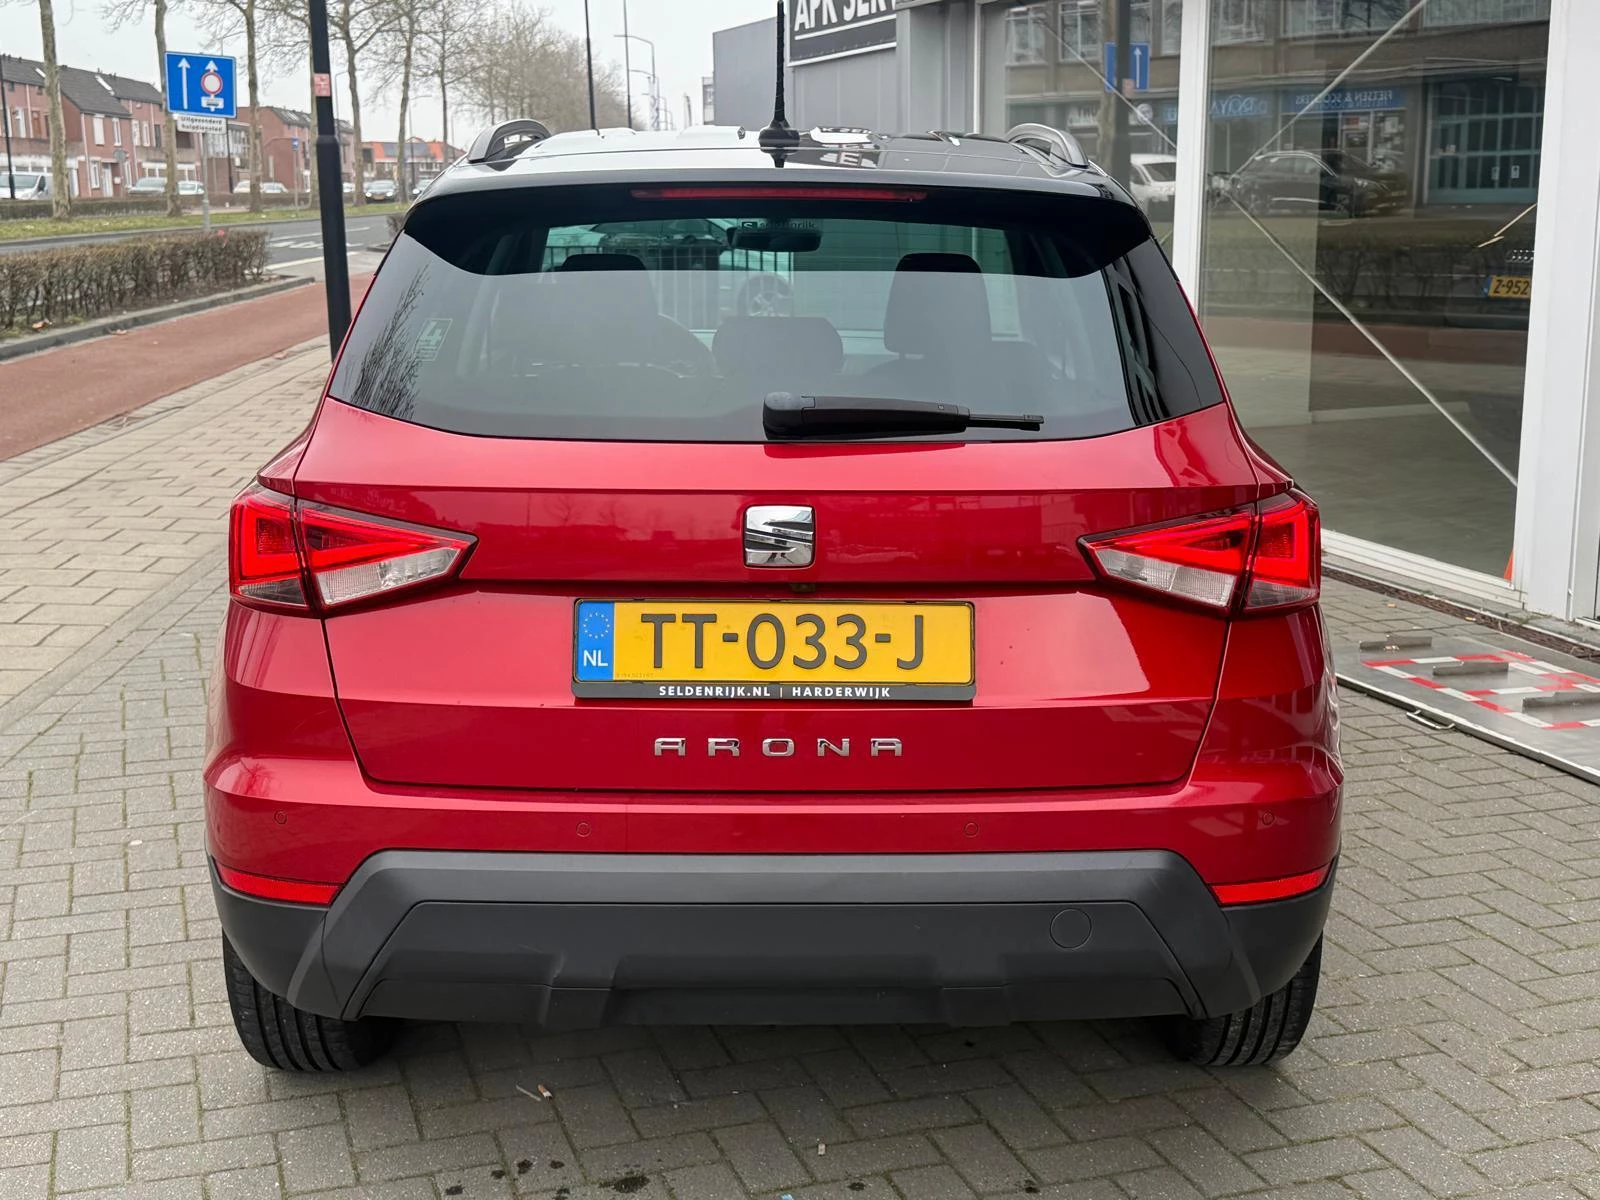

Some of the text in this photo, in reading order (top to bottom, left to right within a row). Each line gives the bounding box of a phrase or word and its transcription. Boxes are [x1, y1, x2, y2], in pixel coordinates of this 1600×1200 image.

[794, 0, 838, 31] APK
[641, 613, 924, 670] TT-033-J
[583, 649, 609, 668] NL
[659, 685, 891, 699] SELDENRIJK.NL HARDERWIJK
[653, 737, 903, 758] ARONA
